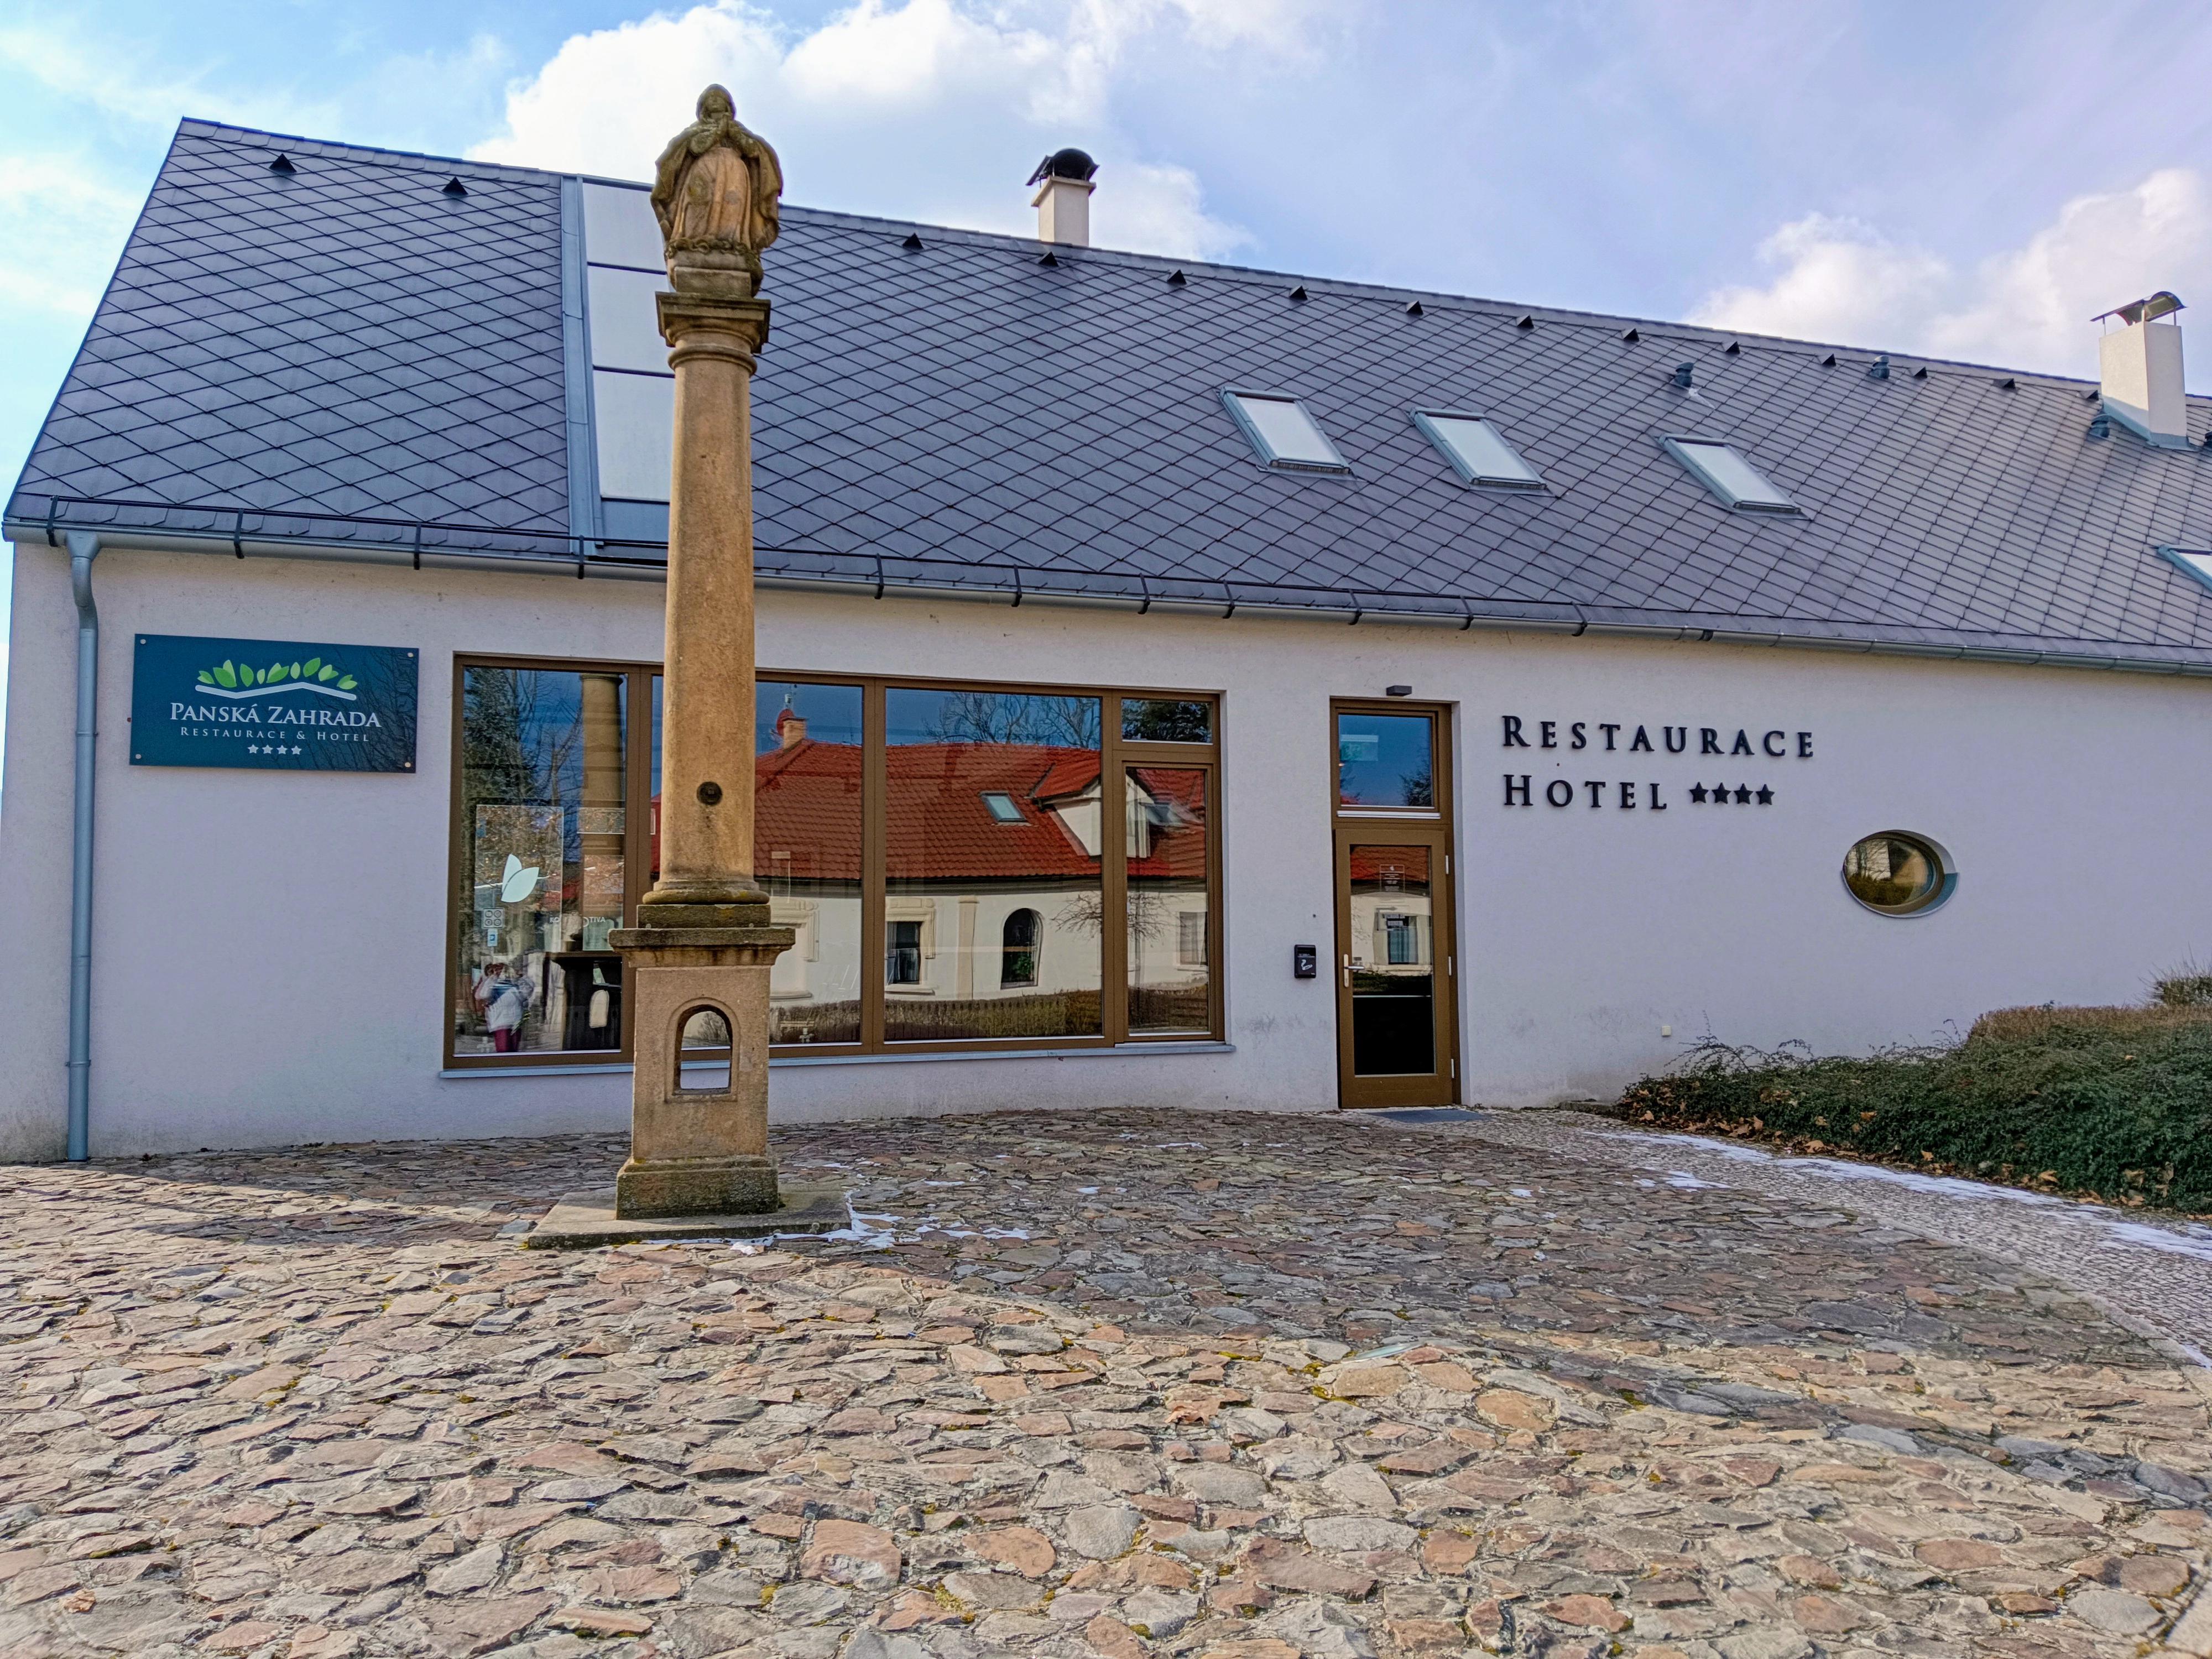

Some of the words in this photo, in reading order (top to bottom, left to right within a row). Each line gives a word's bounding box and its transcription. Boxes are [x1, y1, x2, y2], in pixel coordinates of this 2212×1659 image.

[170, 703, 259, 723] PANSKÁ
[268, 706, 382, 727] ZAHRADA
[181, 727, 286, 739] RESTAURACE
[296, 731, 306, 739] &
[317, 732, 369, 742] HOTEL
[1502, 715, 1813, 758] RESTAURACE
[1503, 774, 1667, 810] HOTEL
